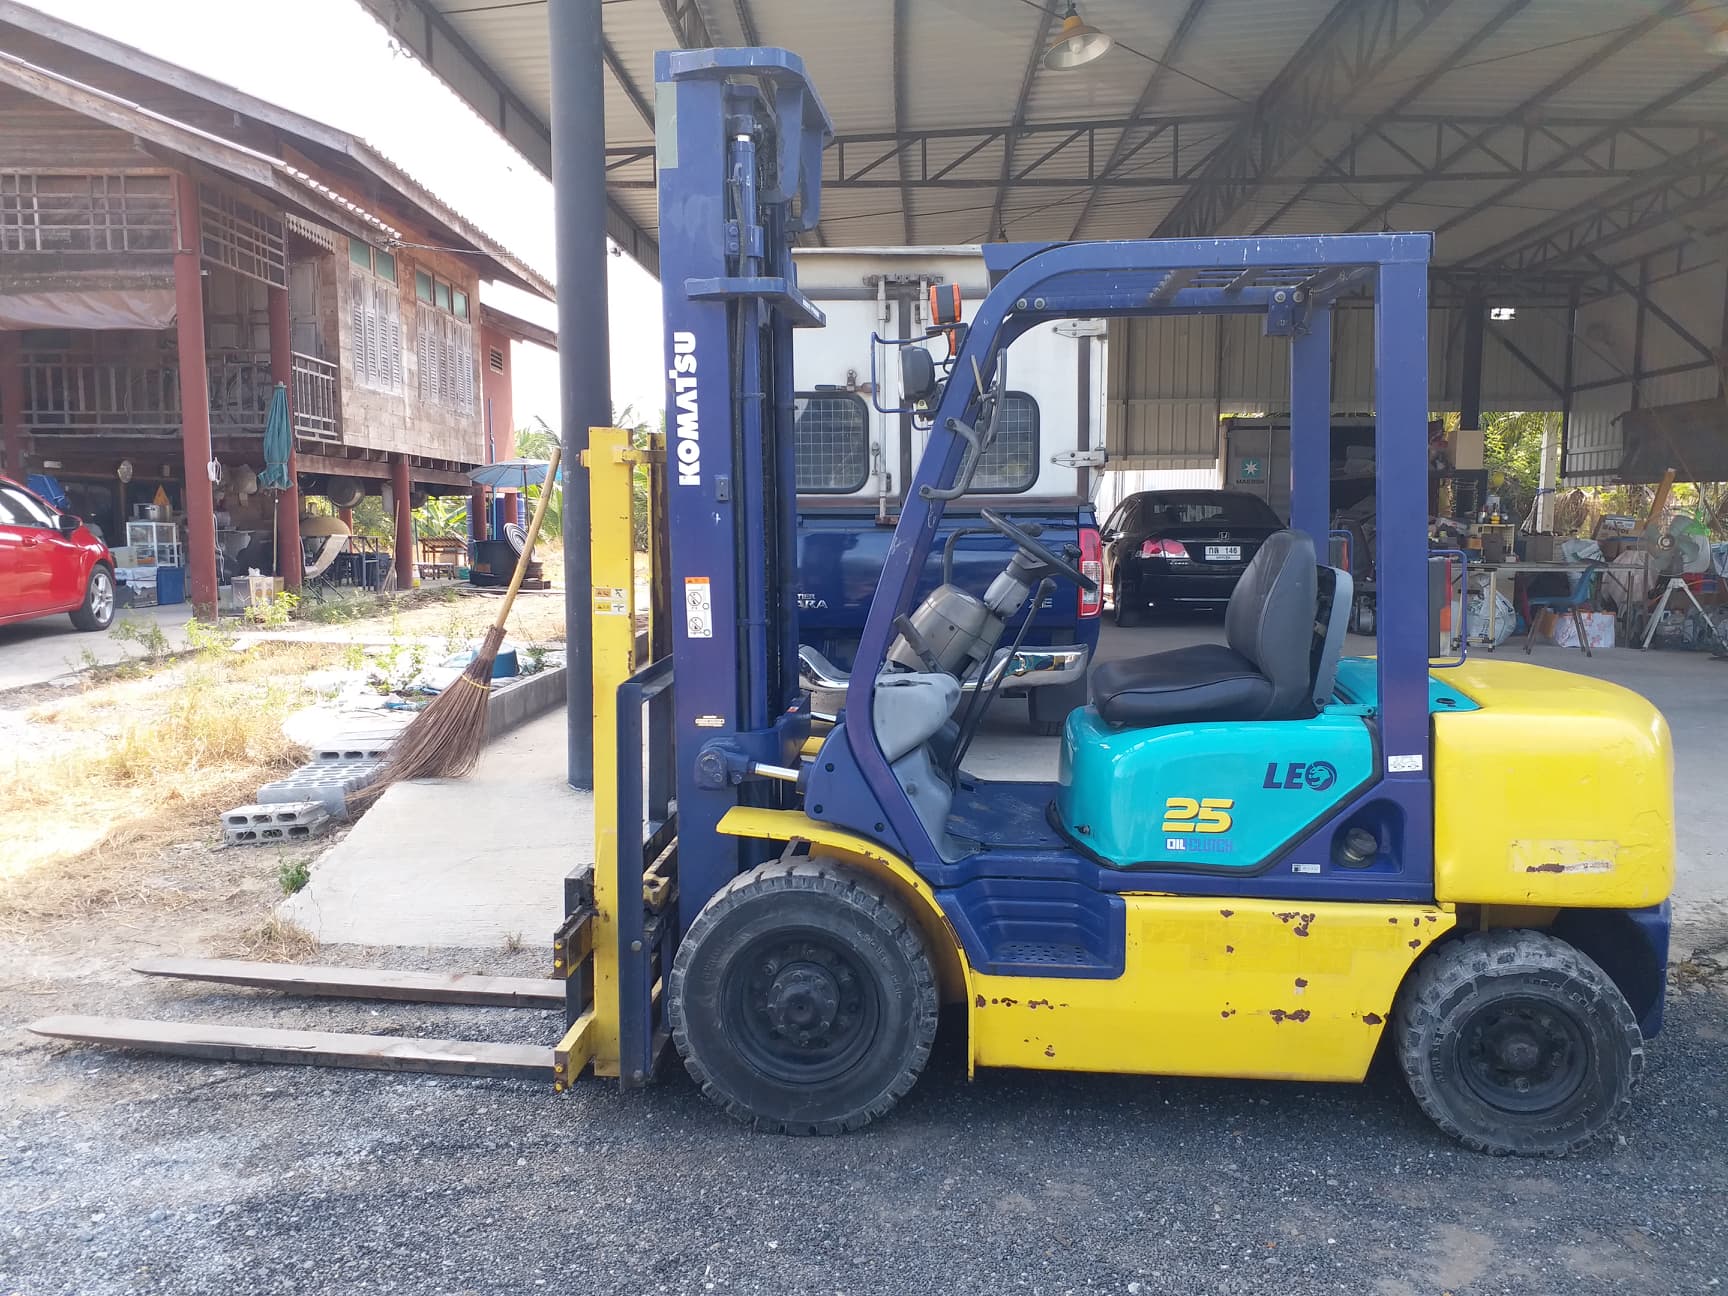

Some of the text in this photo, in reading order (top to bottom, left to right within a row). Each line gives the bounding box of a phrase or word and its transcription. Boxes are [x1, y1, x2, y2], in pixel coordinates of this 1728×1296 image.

[669, 332, 700, 485] KOMATSU
[1263, 761, 1337, 791] LEO
[1162, 798, 1235, 834] 25
[1166, 838, 1232, 852] OIL CLUTCH
